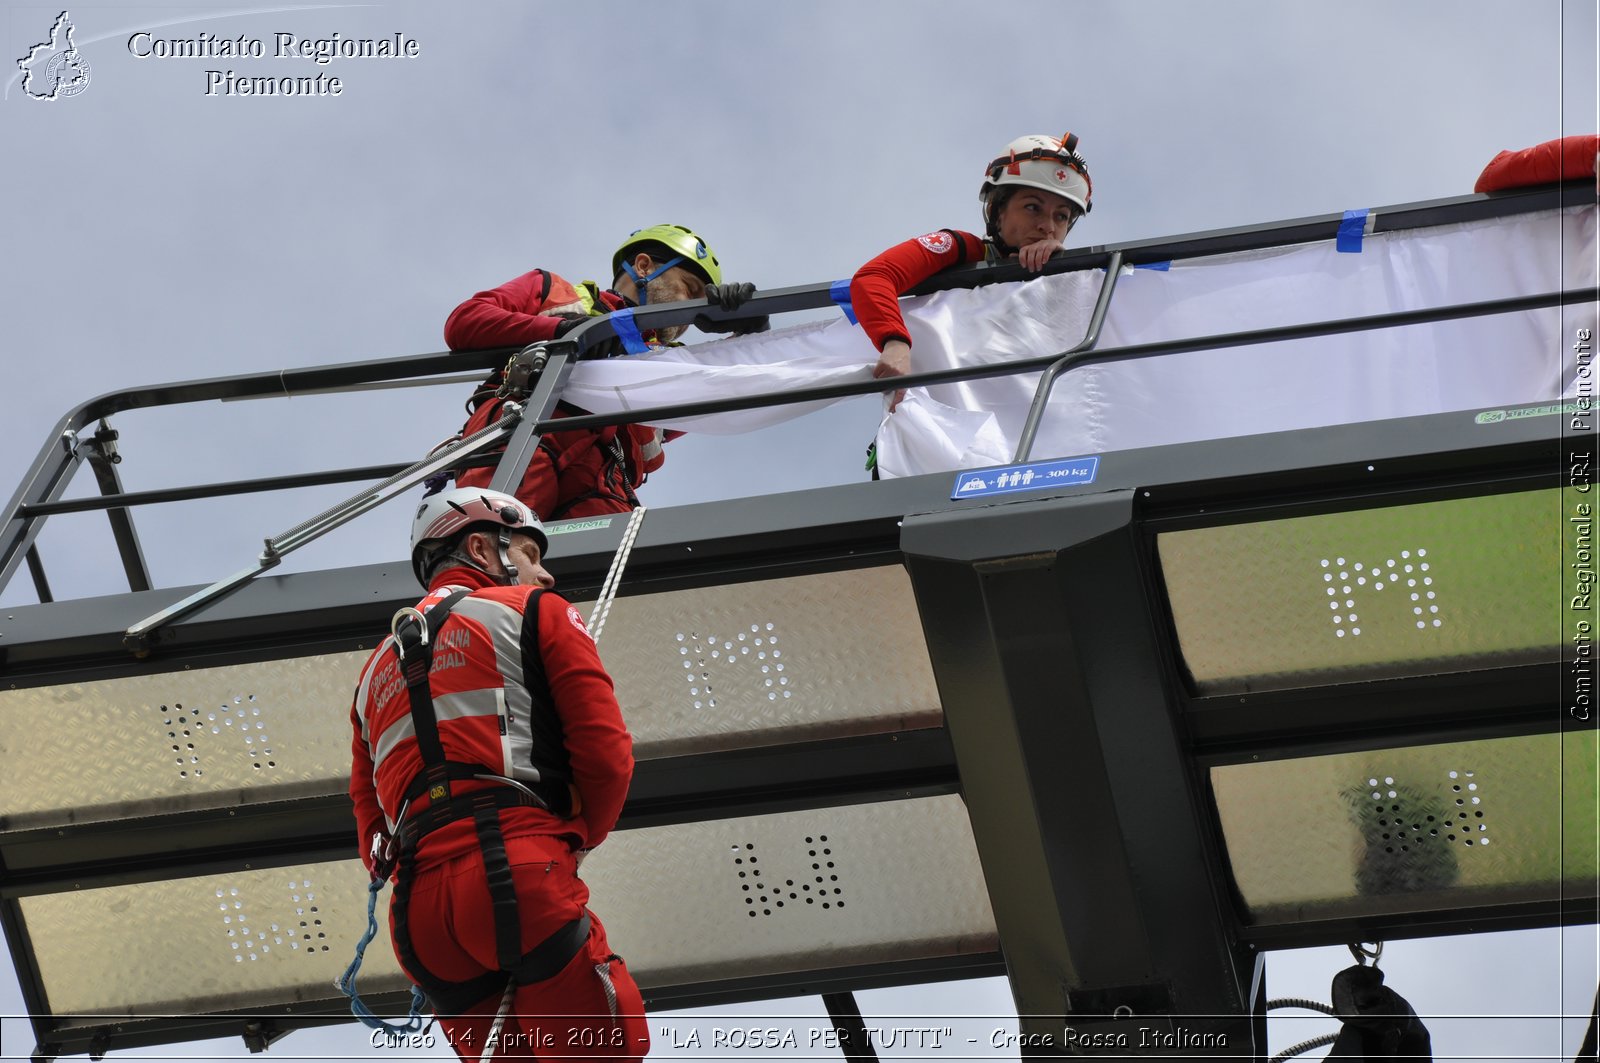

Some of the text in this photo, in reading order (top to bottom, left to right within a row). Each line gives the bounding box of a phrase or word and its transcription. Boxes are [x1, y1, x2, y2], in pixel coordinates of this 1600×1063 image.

[1046, 469, 1069, 479] 300
[1071, 468, 1089, 477] kg
[433, 628, 471, 652] ALIANA
[430, 652, 466, 674] ECIALI
